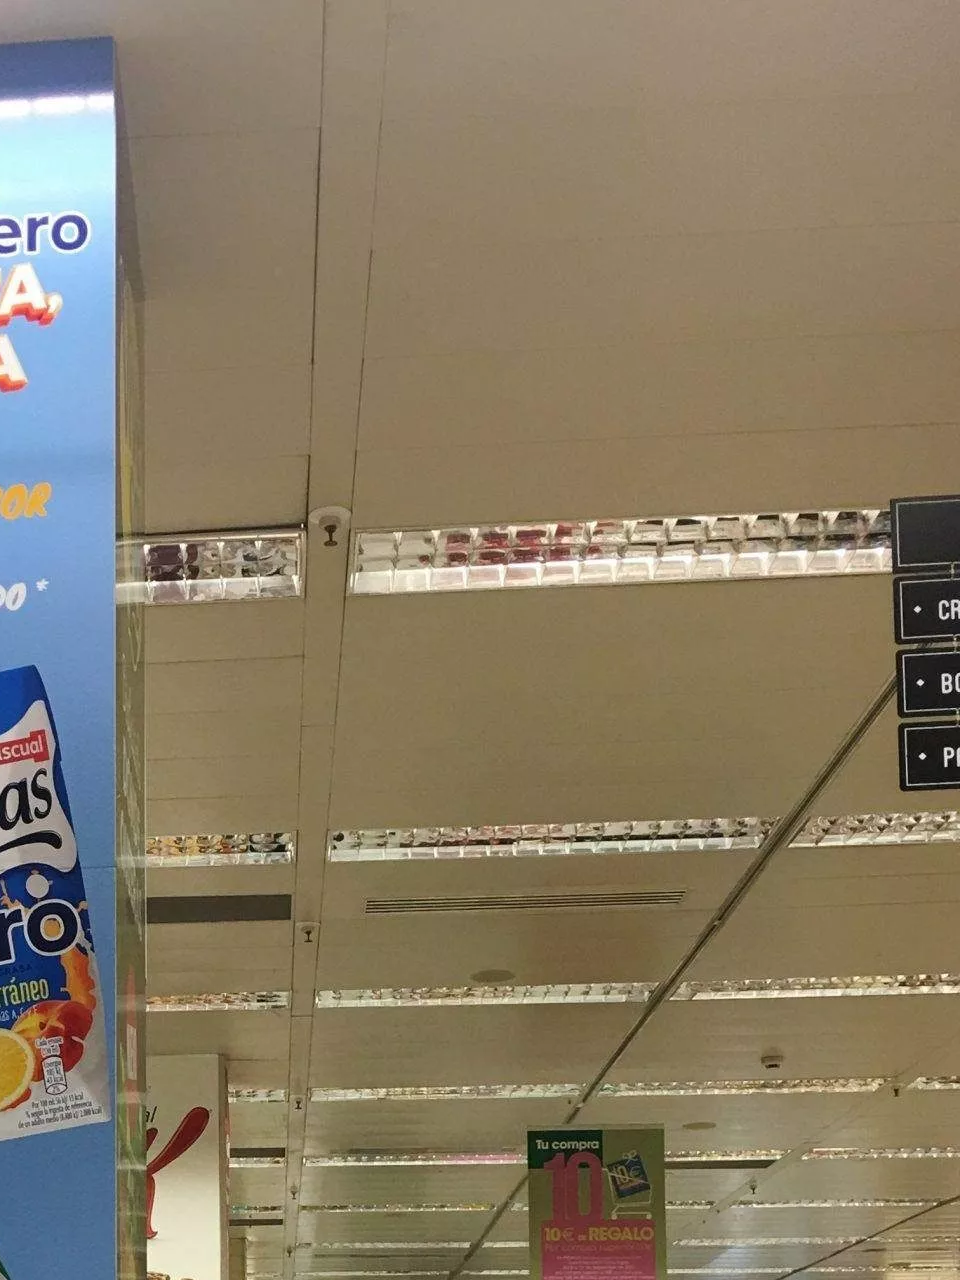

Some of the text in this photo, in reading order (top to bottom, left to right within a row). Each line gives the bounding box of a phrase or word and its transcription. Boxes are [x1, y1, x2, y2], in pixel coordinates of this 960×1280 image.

[536, 1140, 599, 1151] Tu compra
[544, 1152, 603, 1221] 10
[589, 1227, 654, 1240] REGALO
